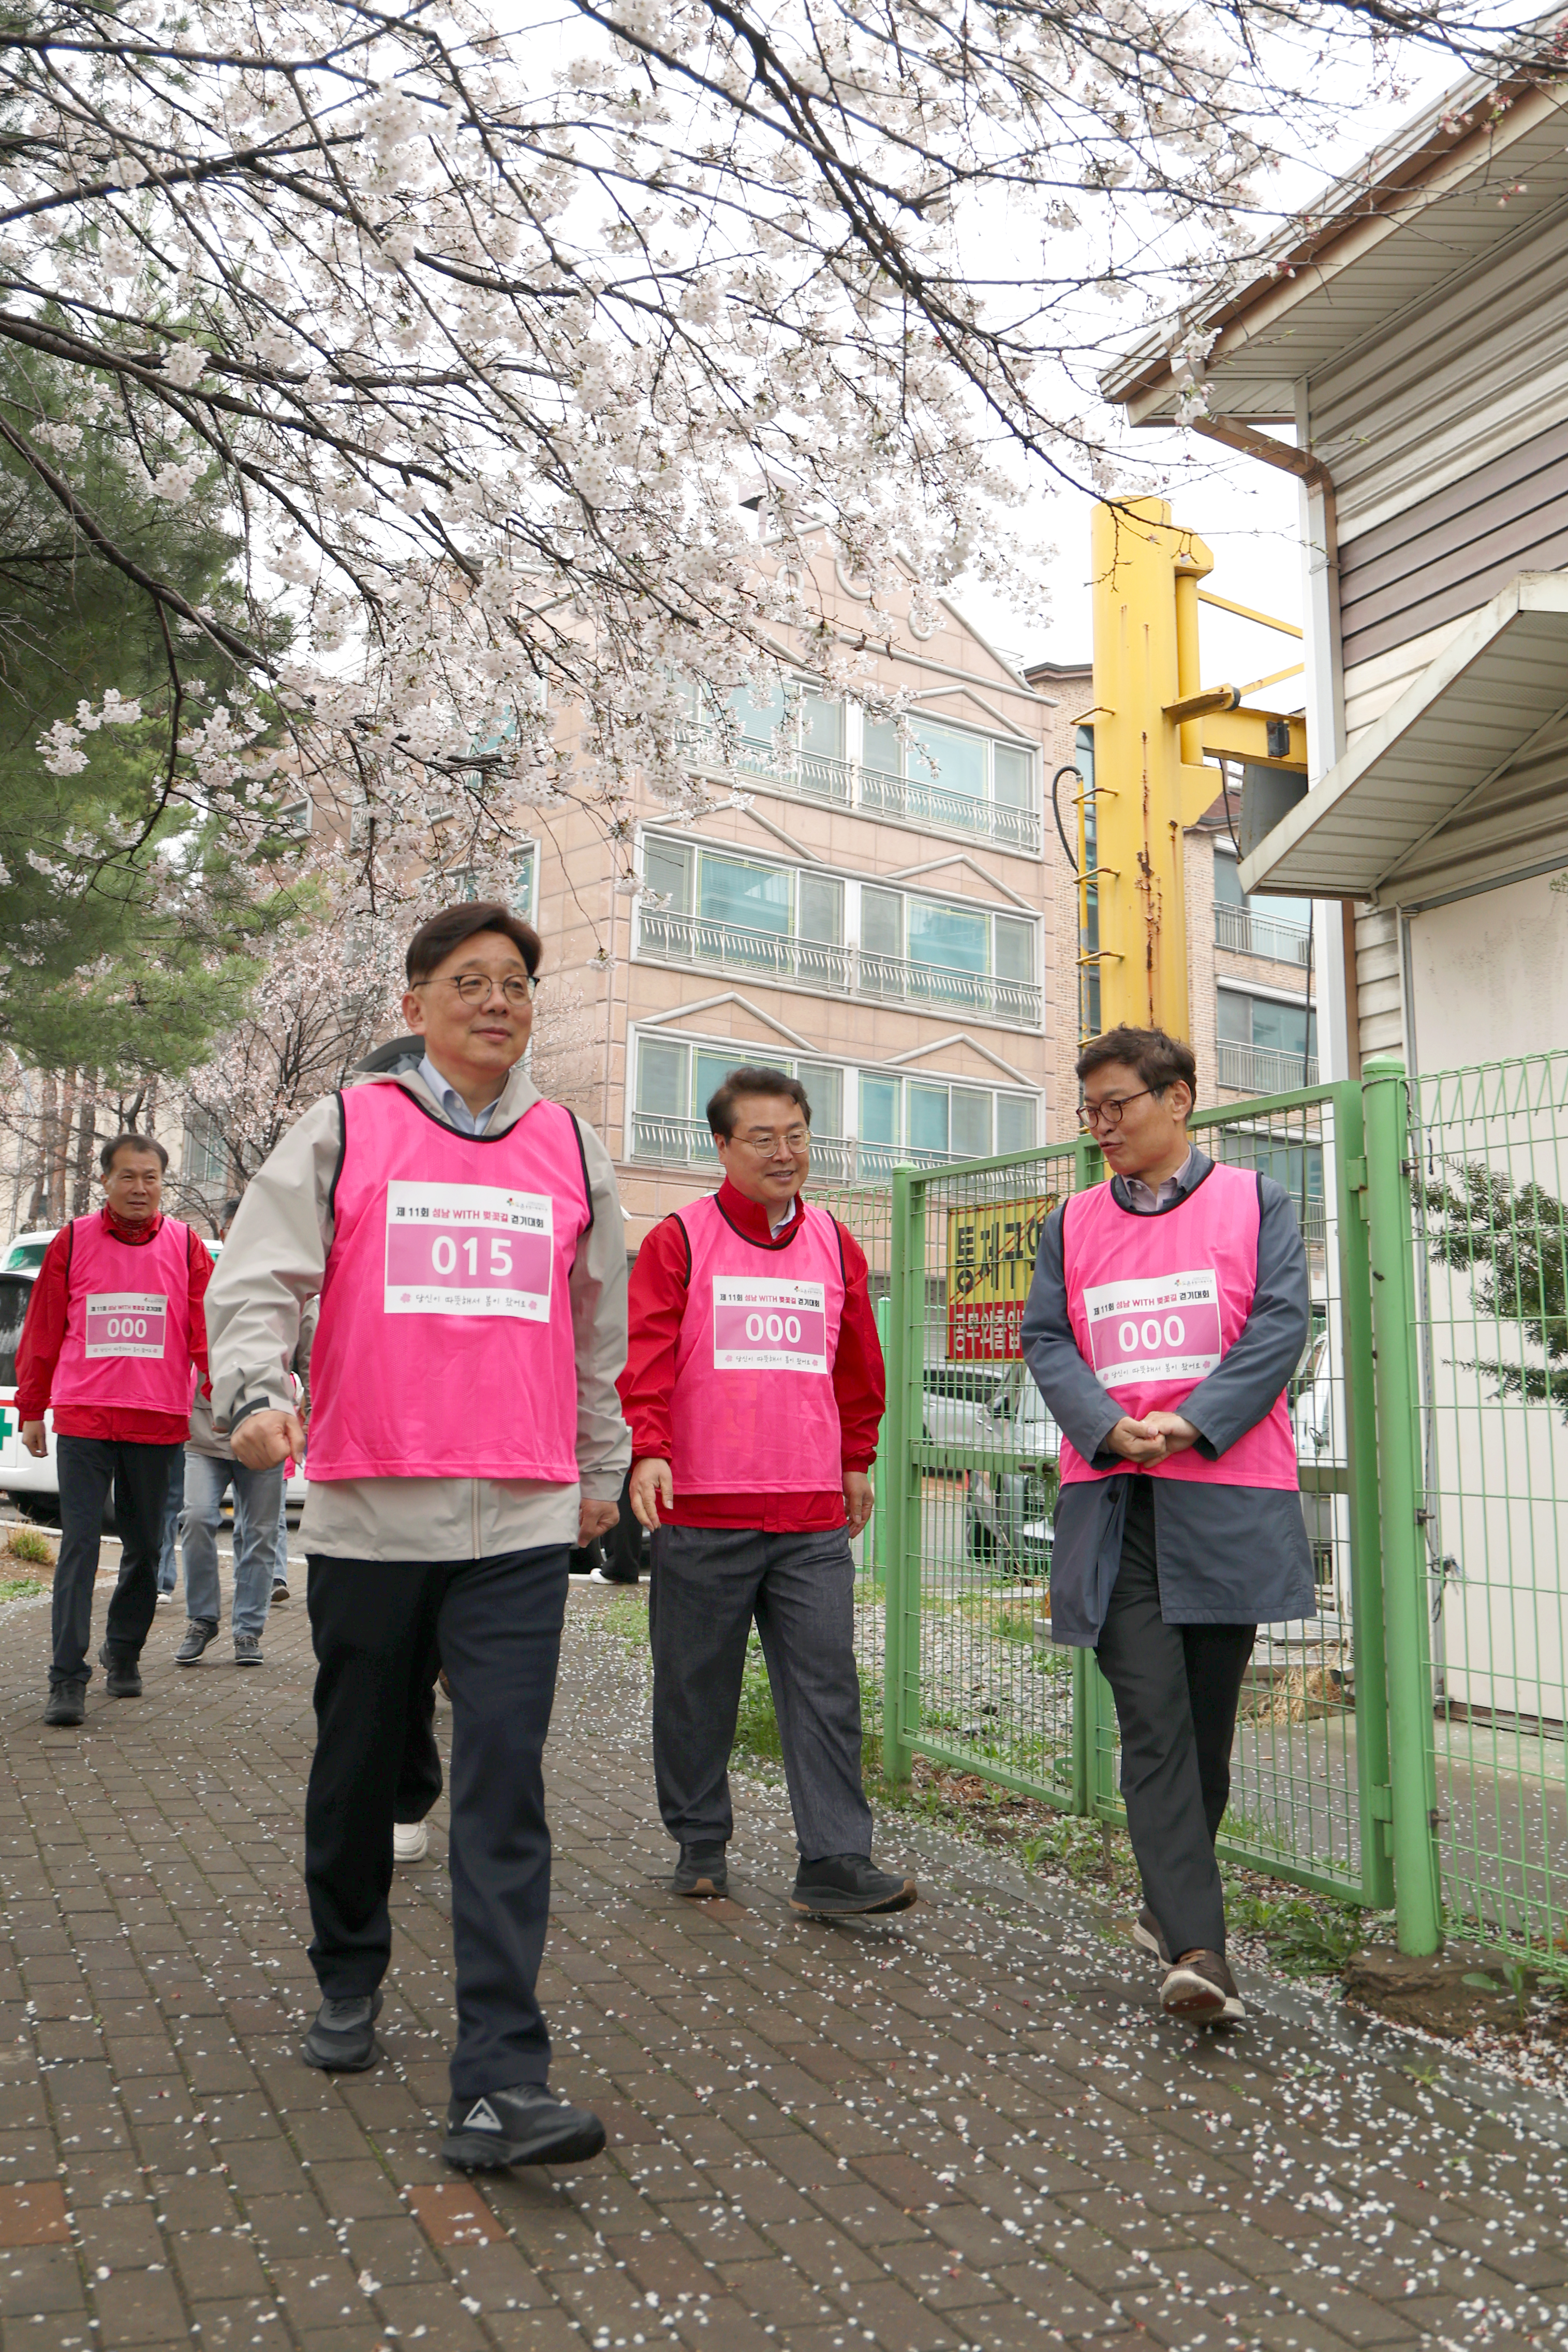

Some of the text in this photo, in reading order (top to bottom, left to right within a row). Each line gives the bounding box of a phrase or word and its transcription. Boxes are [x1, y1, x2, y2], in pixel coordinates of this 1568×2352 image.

[396, 1207, 405, 1217] 제
[409, 1207, 429, 1217] 11회
[433, 1208, 450, 1219] 성남
[453, 1210, 480, 1219] WITH
[511, 1215, 544, 1228] 걷기대회
[431, 1235, 513, 1277] 015
[416, 1294, 440, 1304] 당신이
[485, 1296, 499, 1307] 봄이
[779, 1296, 796, 1304] 벚꽃길
[798, 1298, 819, 1307] 걷기대회
[1093, 1307, 1100, 1315] 제
[1101, 1303, 1114, 1312] 11회
[1132, 1298, 1155, 1307] WITH
[1179, 1290, 1209, 1300] 걷기대회
[107, 1318, 147, 1338] 000
[745, 1313, 801, 1343] 000
[956, 1309, 1025, 1351] 공무외출입
[1119, 1315, 1185, 1352] 000
[1111, 1369, 1128, 1379] 당신이
[1165, 1363, 1177, 1372] 봄이
